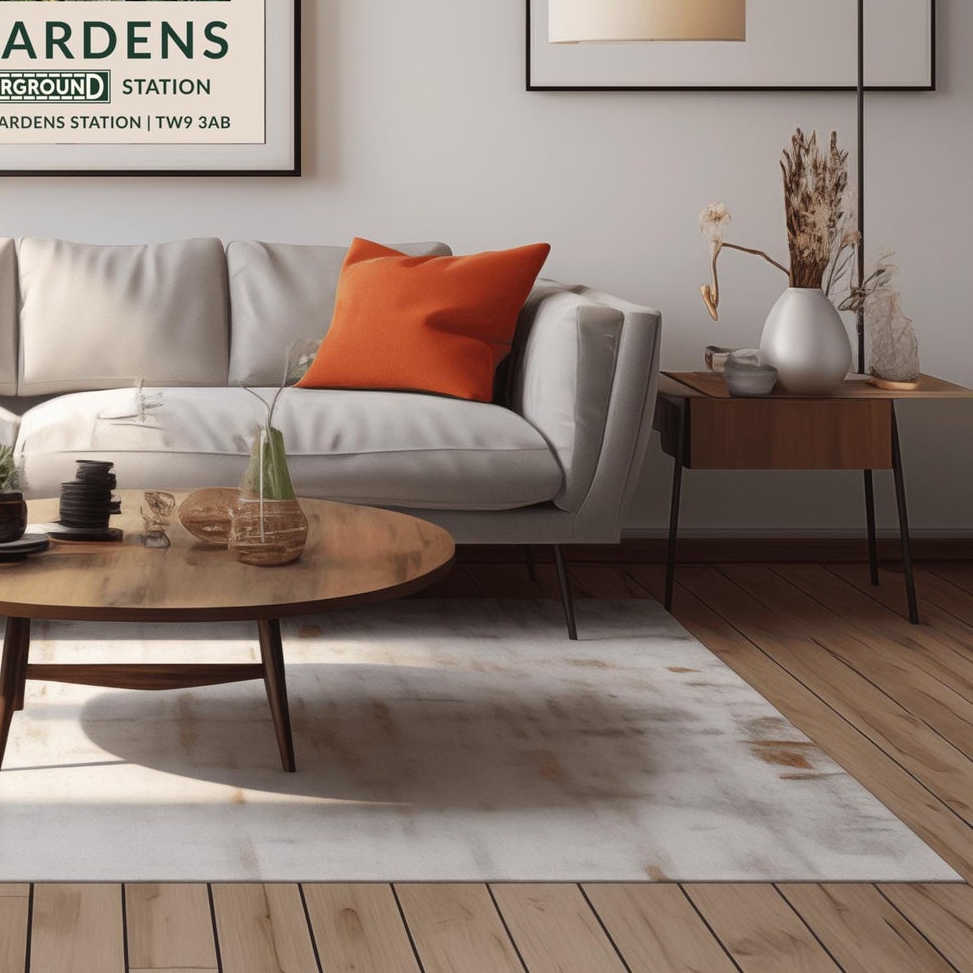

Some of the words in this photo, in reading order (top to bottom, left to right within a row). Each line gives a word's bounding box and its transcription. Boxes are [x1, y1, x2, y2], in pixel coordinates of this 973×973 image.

[122, 78, 211, 96] STATION
[70, 115, 142, 130] STATION
[154, 115, 193, 130] TW9
[198, 115, 231, 130] 3AB
